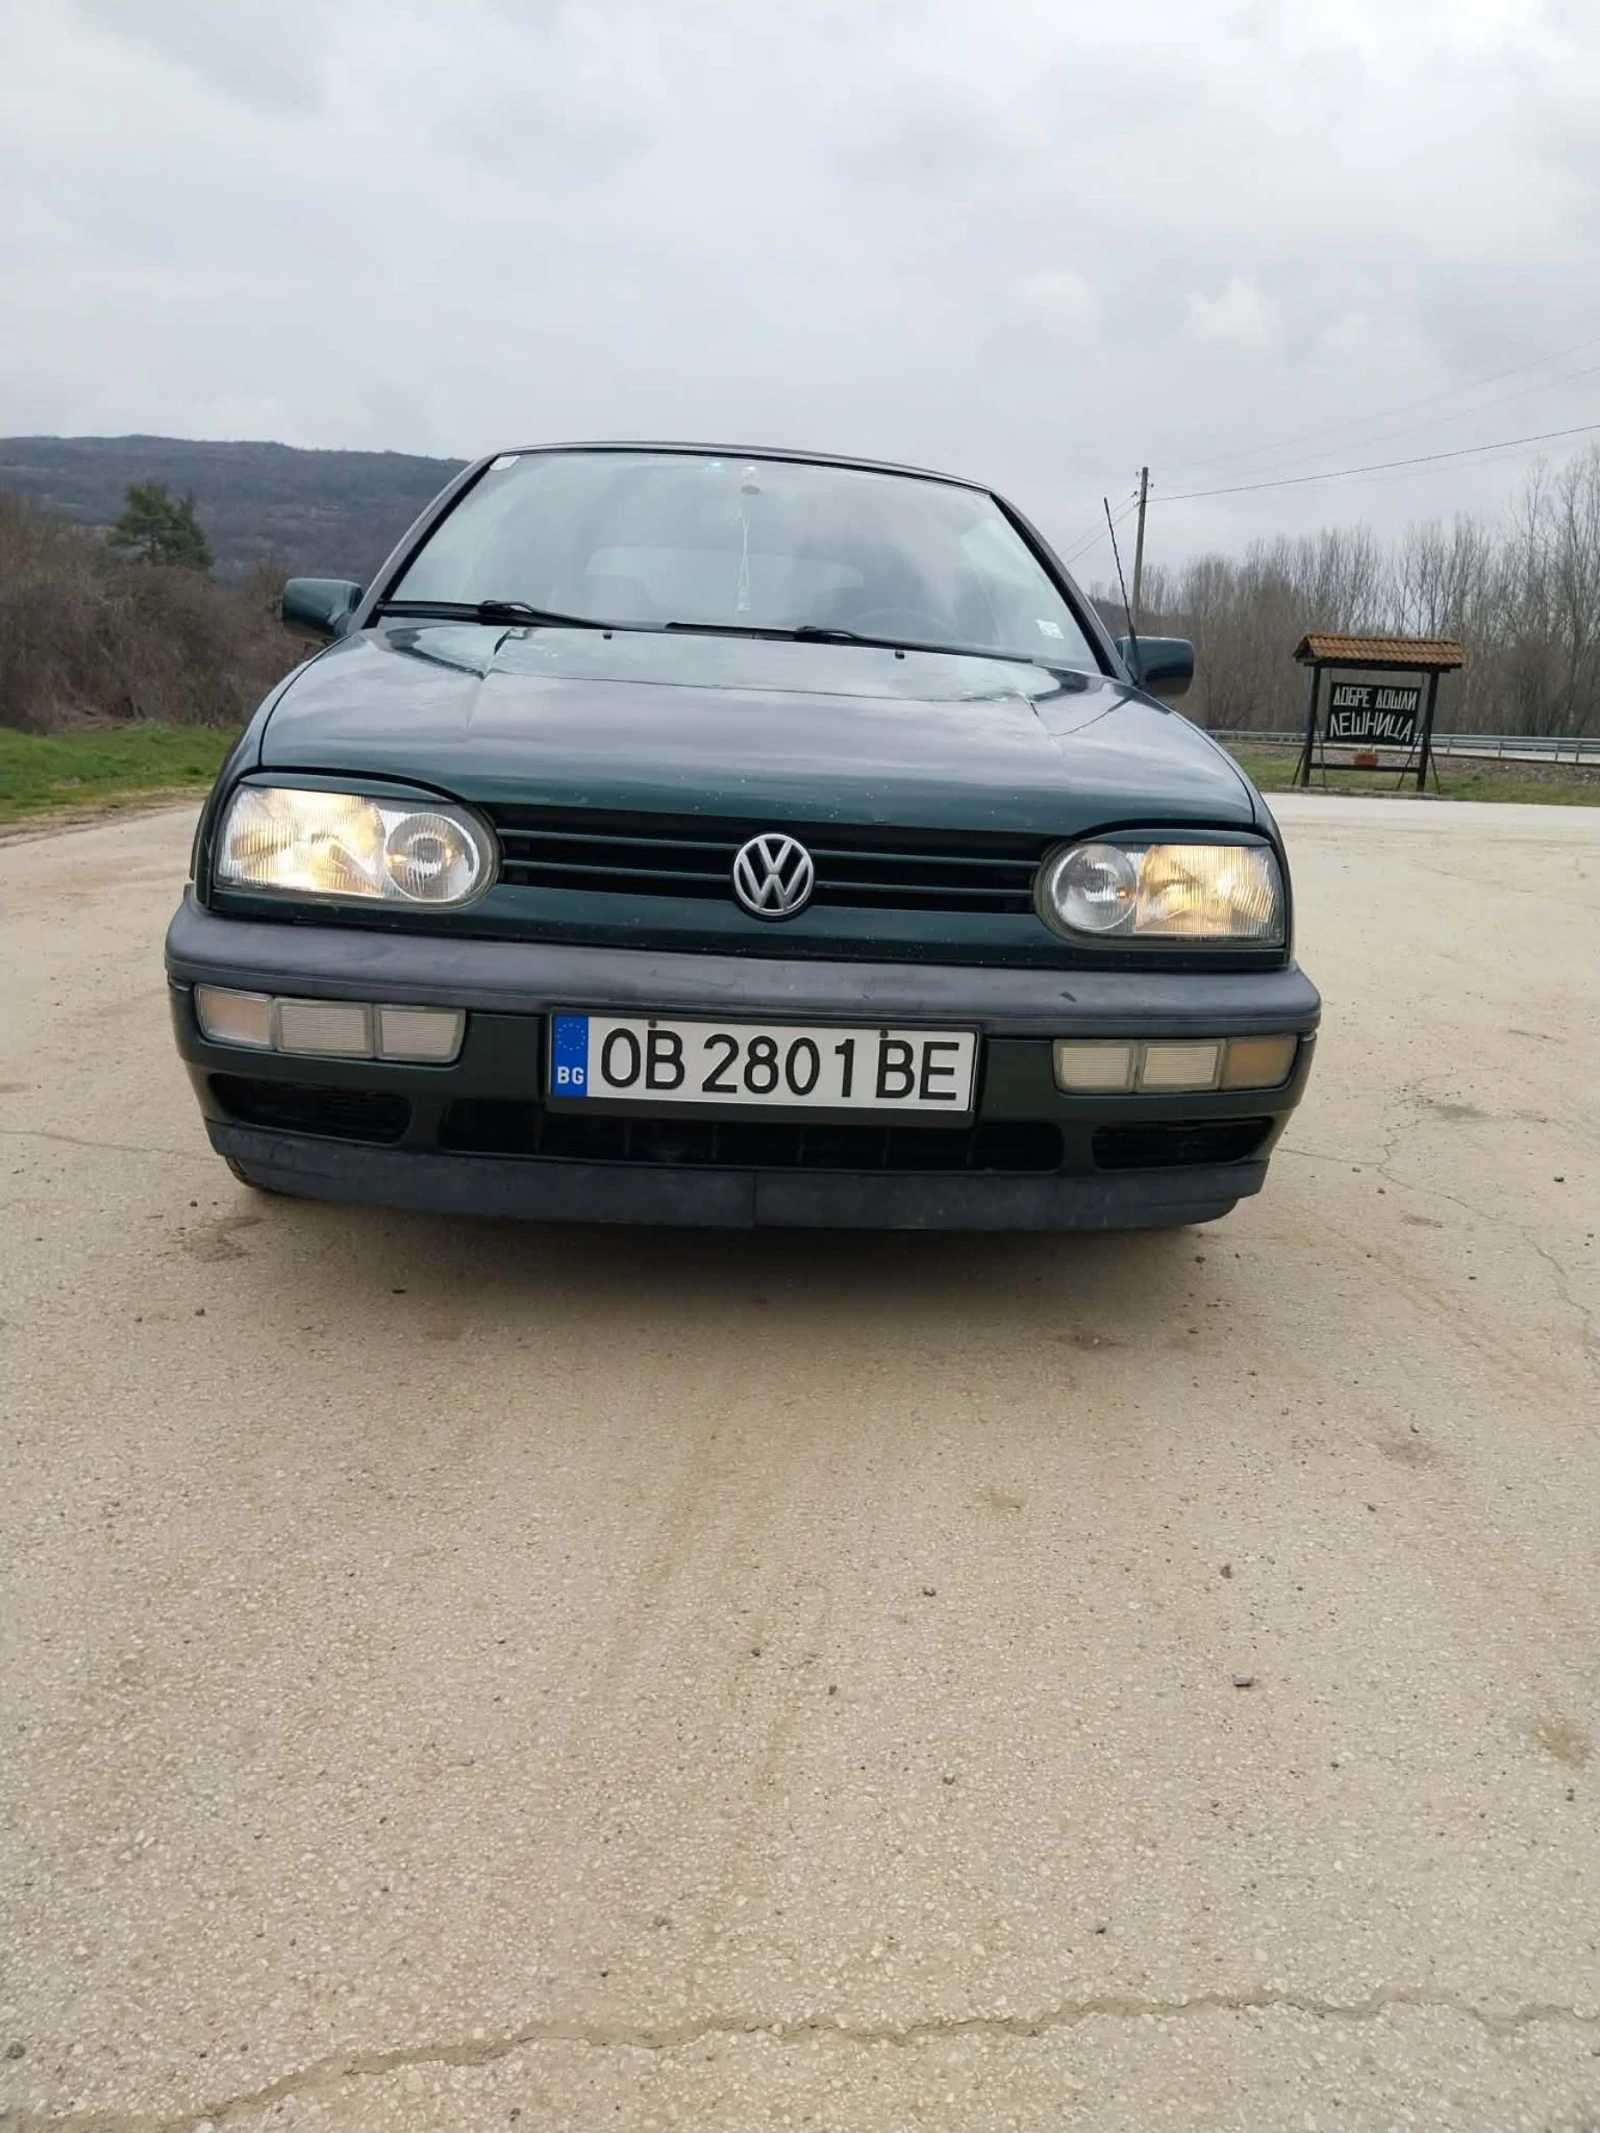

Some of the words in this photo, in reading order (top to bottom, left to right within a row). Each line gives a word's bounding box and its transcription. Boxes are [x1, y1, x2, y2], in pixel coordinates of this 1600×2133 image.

[1333, 686, 1372, 708] ДОБРЕ
[1375, 689, 1418, 711] ДОШЛИ
[1329, 711, 1414, 742] ЛЕШНИЦА
[557, 1066, 585, 1085] BG
[701, 1033, 856, 1098] 2801
[875, 1039, 960, 1101] BE
